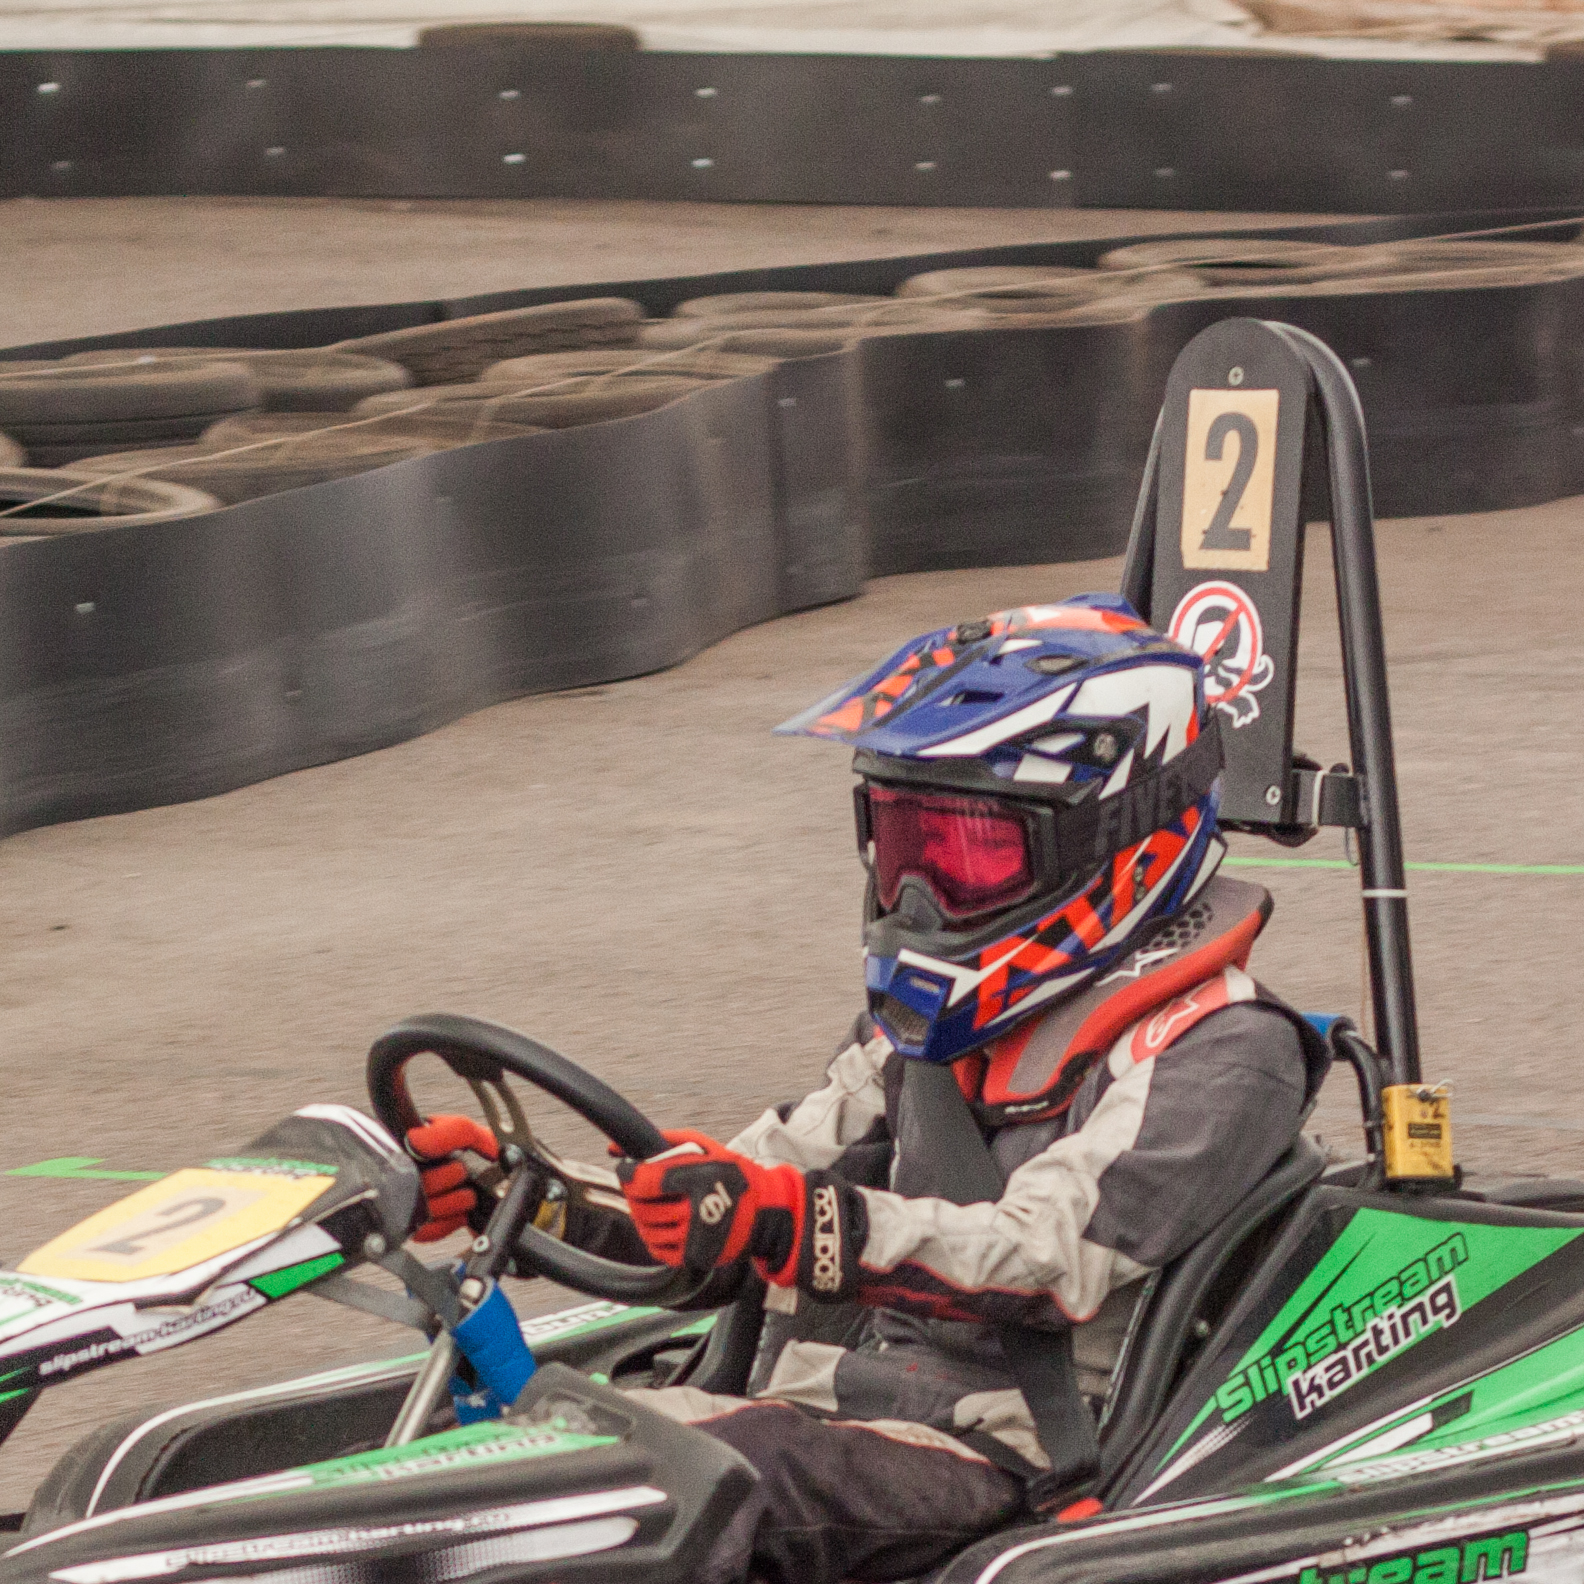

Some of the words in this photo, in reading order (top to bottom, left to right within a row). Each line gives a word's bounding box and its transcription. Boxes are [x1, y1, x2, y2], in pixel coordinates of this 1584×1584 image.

[1199, 411, 1260, 551] 2
[87, 1196, 227, 1256] 2
[1216, 1231, 1469, 1424] Slipstream
[1287, 1273, 1461, 1419] karting
